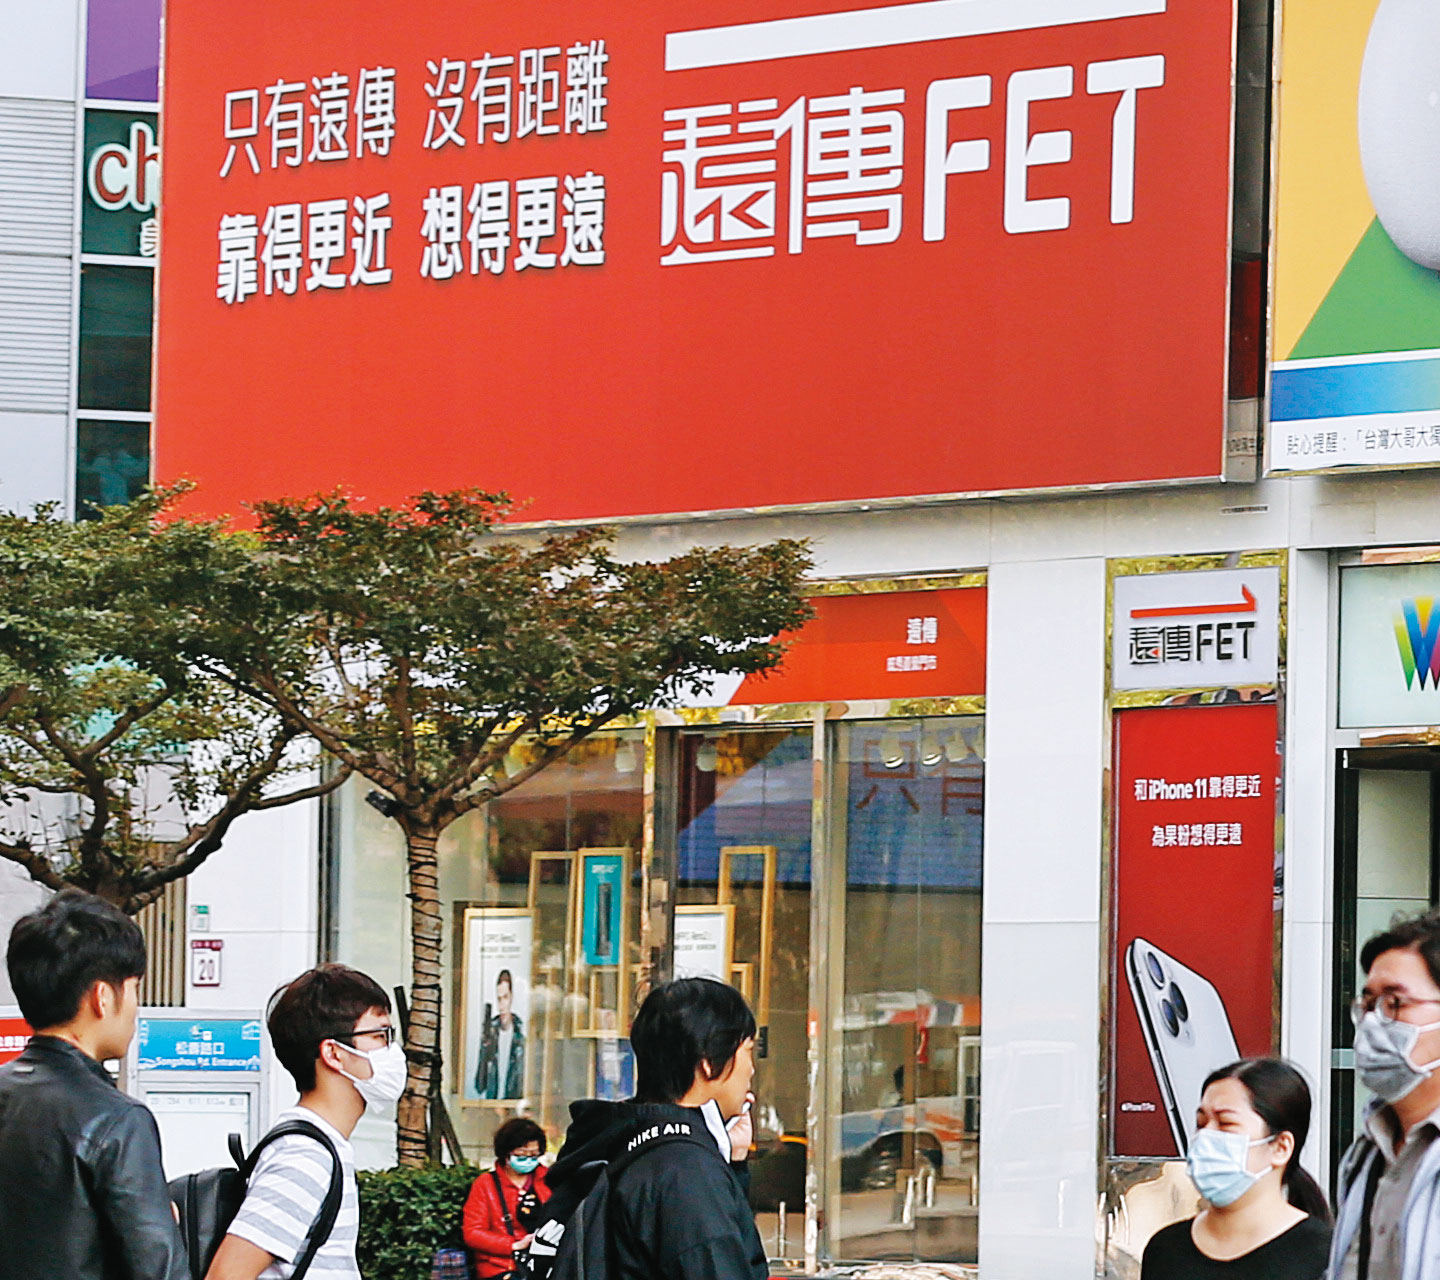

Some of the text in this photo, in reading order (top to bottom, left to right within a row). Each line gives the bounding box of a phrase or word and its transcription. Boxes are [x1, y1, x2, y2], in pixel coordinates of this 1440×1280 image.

[218, 39, 609, 179] 只有遠傳 沒有距離
[216, 170, 606, 305] 靠得更近 想得更遠
[627, 1123, 691, 1152] NIKE AIR
